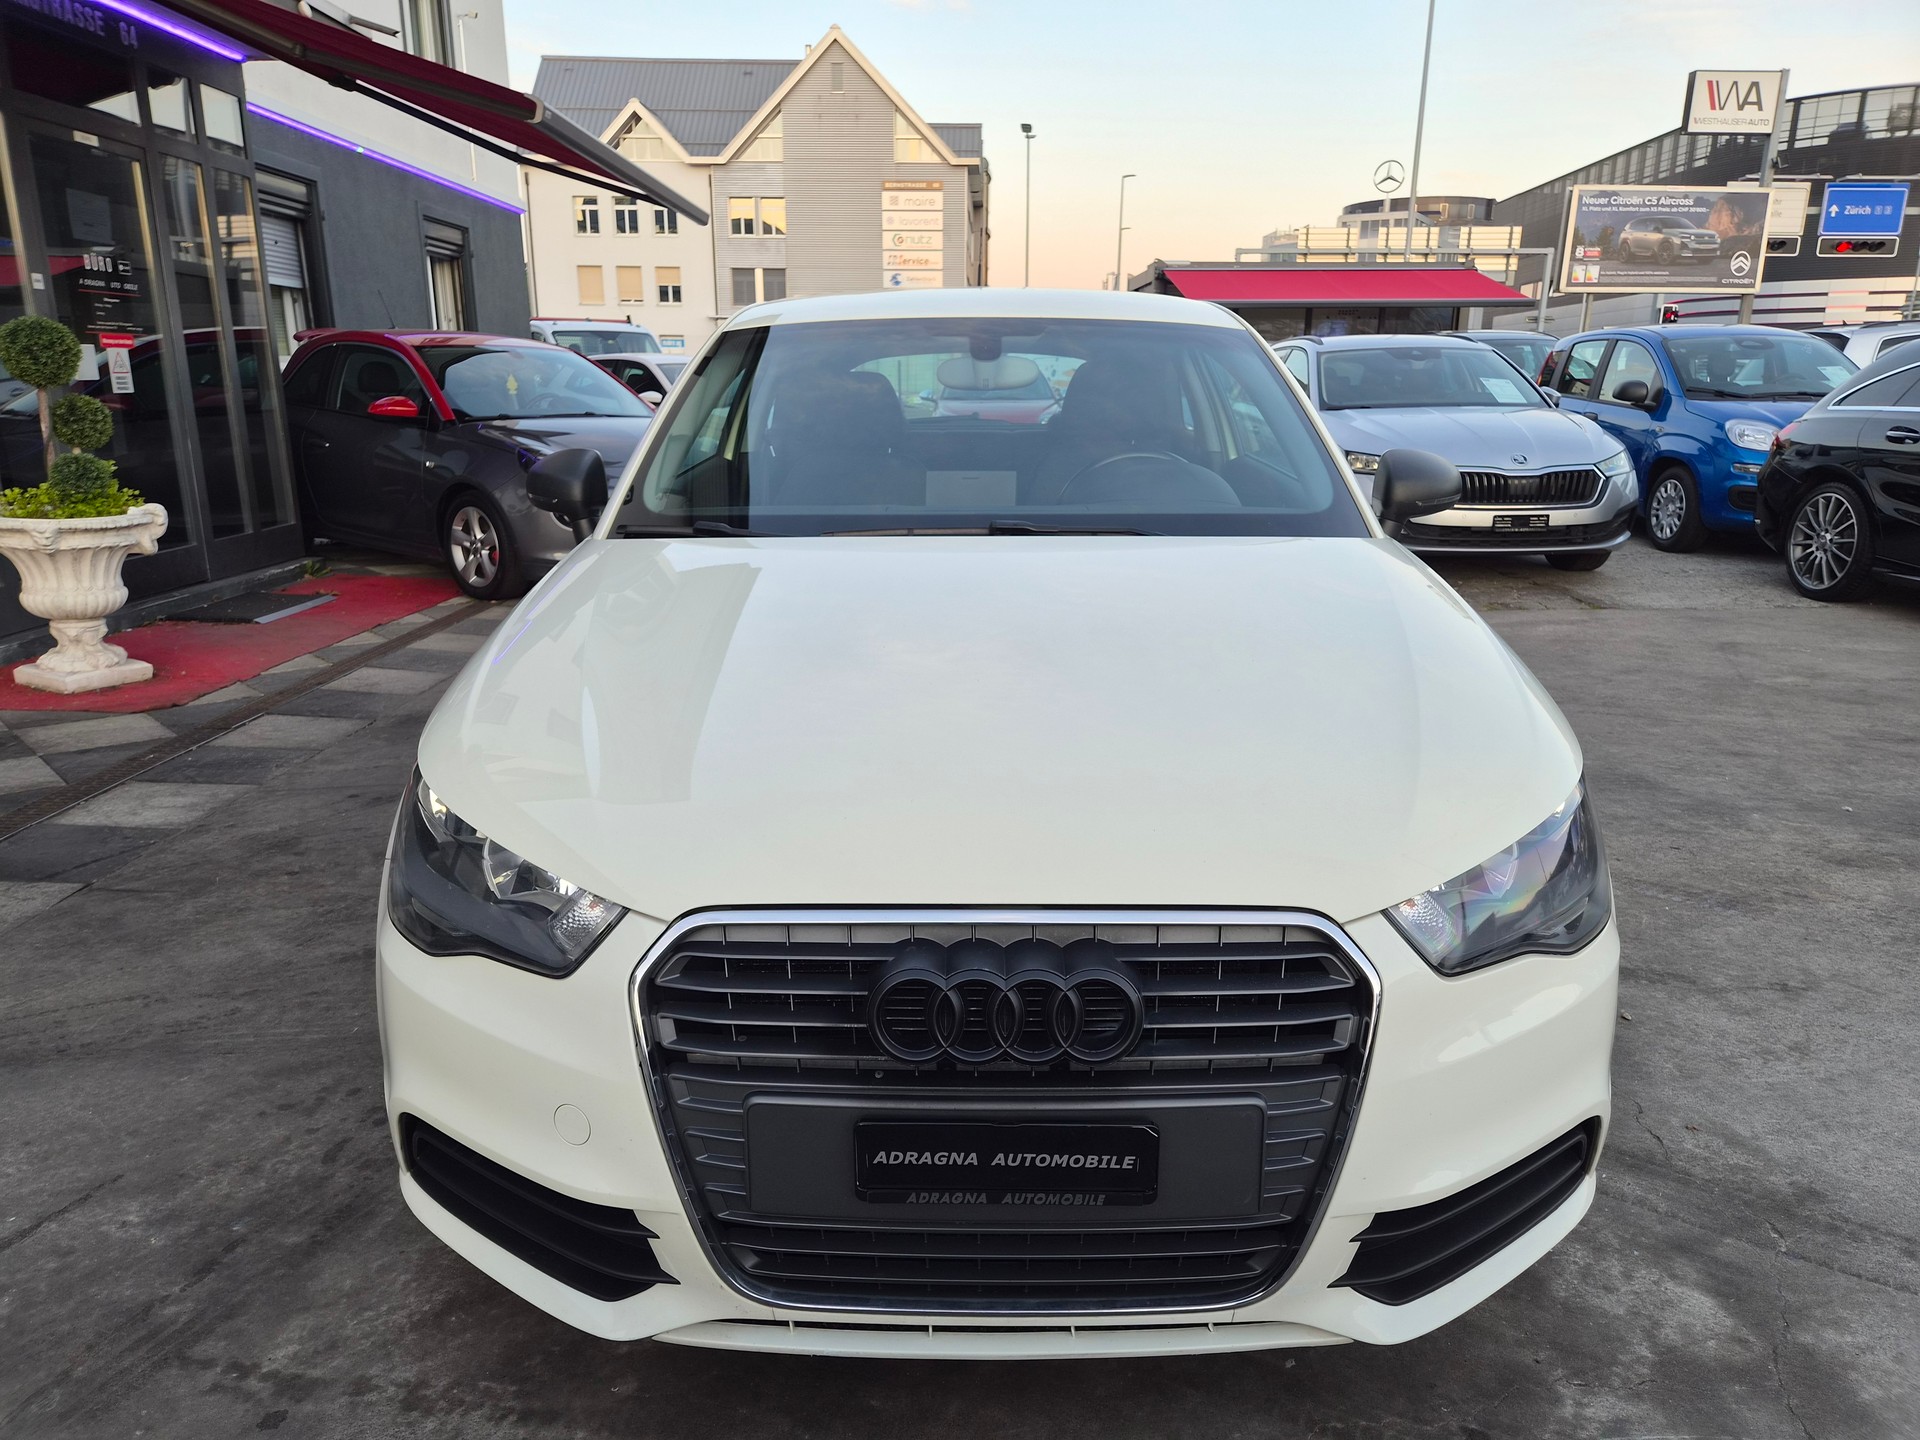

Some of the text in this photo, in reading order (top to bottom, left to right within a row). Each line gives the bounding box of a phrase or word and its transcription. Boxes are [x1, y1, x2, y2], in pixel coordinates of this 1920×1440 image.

[119, 21, 138, 49] 64
[1582, 195, 1694, 206] Neuer Citroën C5 Aircross
[1844, 205, 1872, 215] Zürich
[873, 1151, 1136, 1170] ADRAGNA AUTOMOBILE
[906, 1191, 1106, 1206] ADRAGNA AUTOMOBILE
